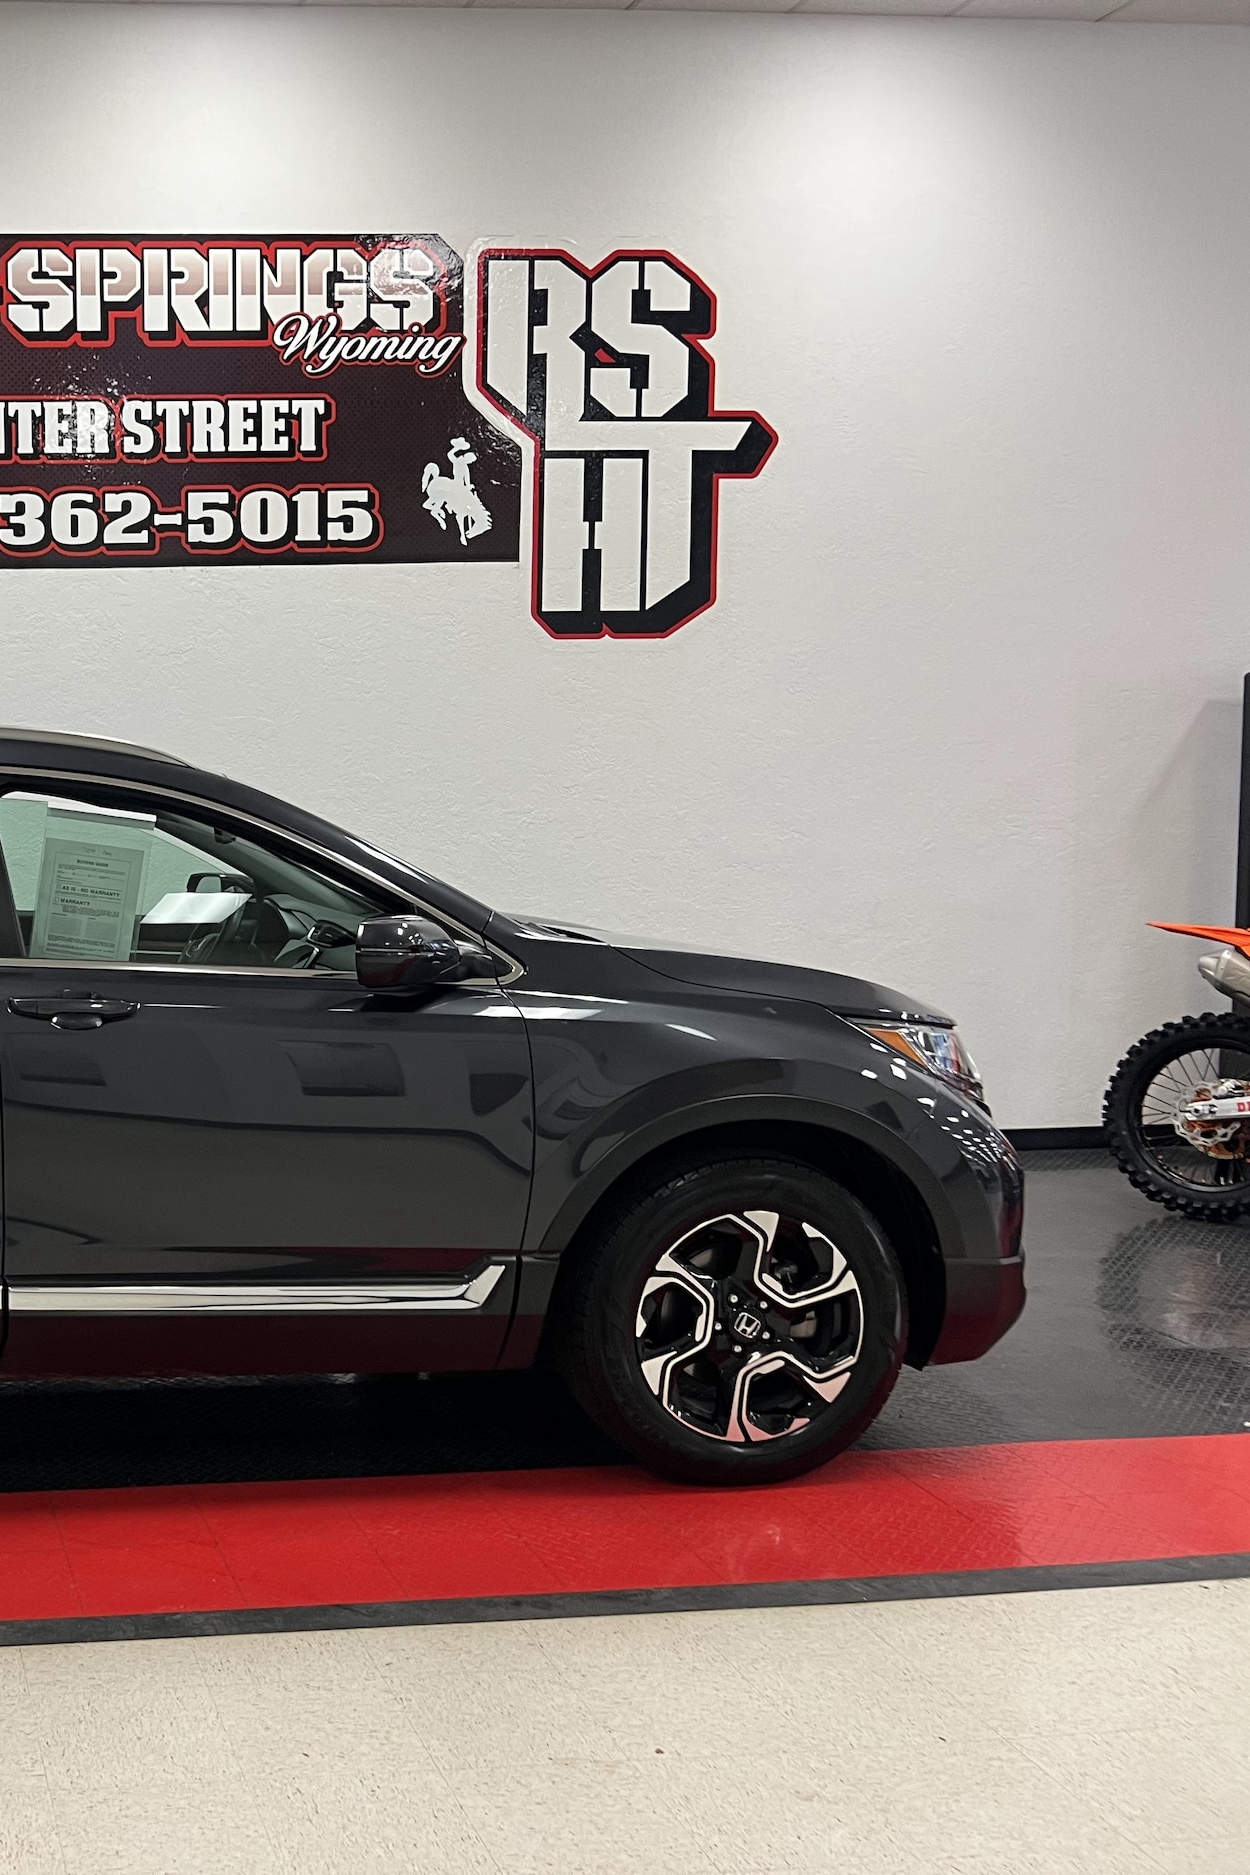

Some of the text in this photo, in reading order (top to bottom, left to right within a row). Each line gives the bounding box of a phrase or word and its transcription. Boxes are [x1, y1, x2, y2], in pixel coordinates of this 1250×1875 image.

[274, 313, 463, 373] Wyoming
[122, 399, 326, 455] STREET
[60, 898, 90, 906] WARRANTY
[90, 889, 120, 897] WARRANTY
